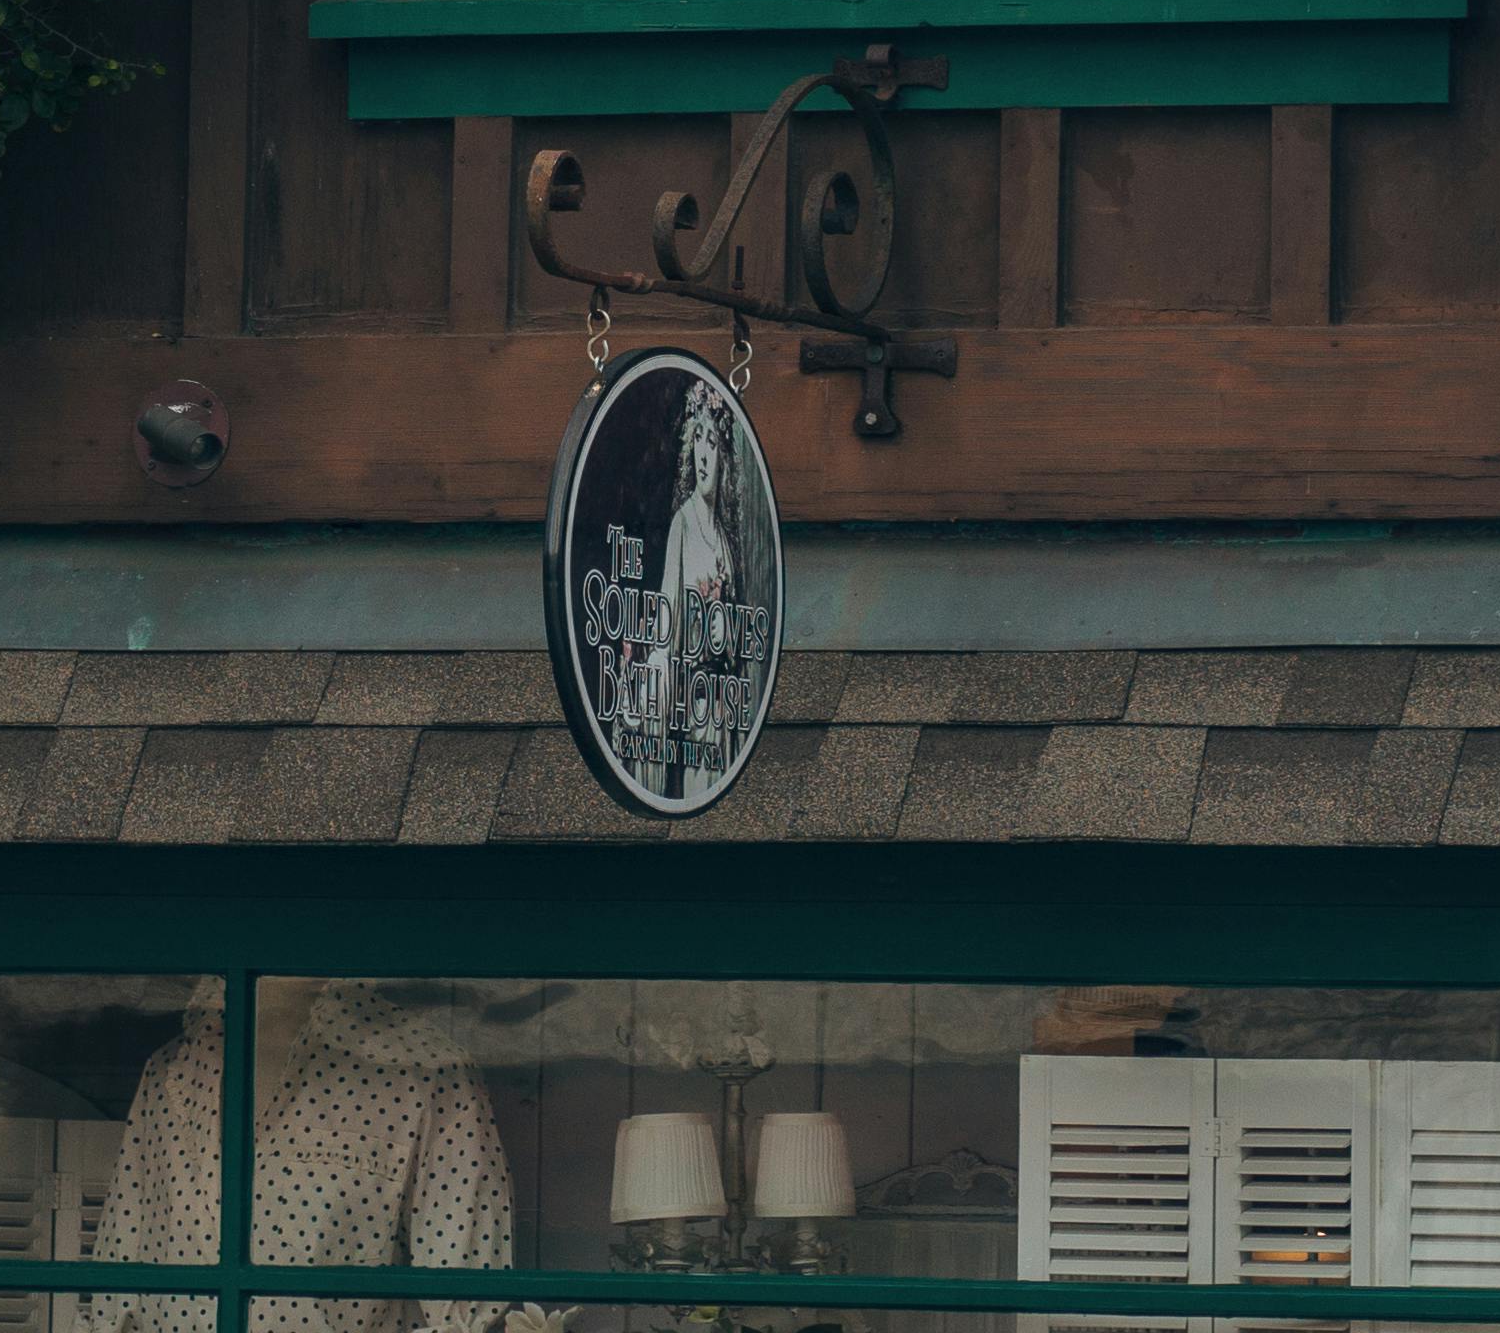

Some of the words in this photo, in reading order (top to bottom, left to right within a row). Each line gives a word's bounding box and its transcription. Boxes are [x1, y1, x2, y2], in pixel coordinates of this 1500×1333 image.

[607, 523, 643, 582] THE
[583, 569, 674, 646] SOILED
[683, 585, 770, 661] DOVES
[598, 645, 662, 721] BATH
[670, 657, 751, 732] HOUSE
[619, 734, 664, 763] CARMEL
[666, 739, 680, 764] BY
[683, 741, 700, 767] THE
[704, 744, 724, 770] SEA
